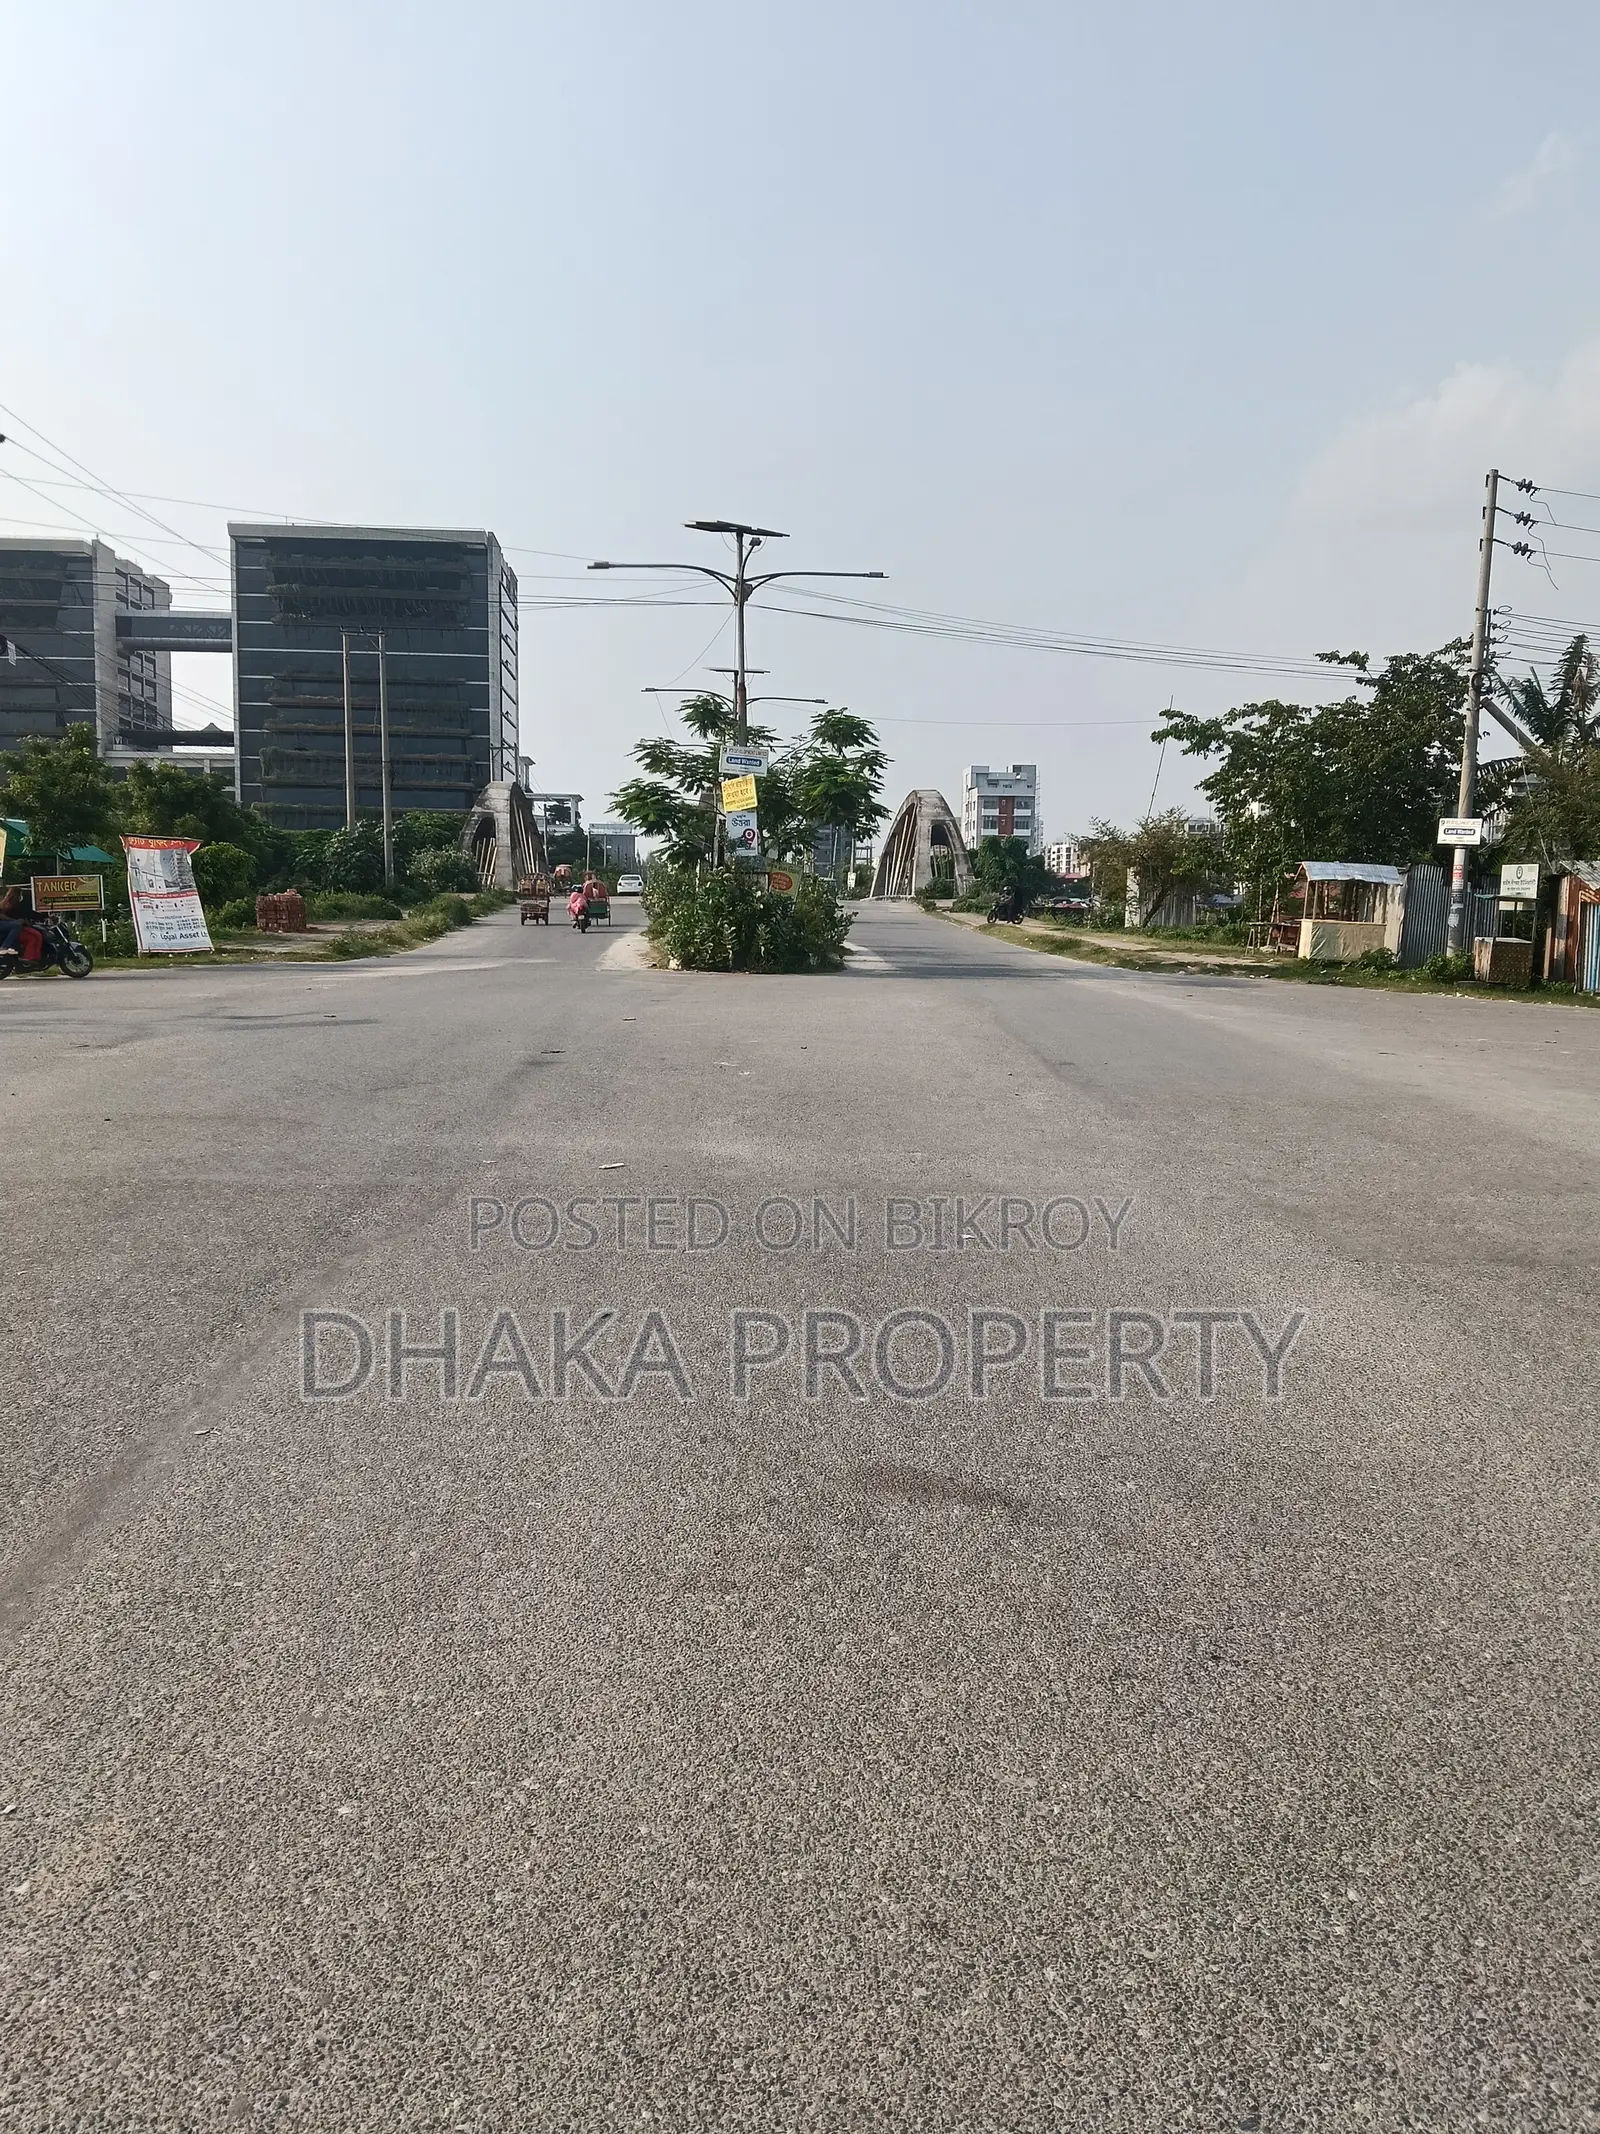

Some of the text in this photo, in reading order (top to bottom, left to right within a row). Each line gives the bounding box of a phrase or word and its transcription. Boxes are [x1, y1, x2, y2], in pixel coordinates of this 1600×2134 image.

[741, 758, 760, 766] Wanted
[731, 817, 751, 827] উত্তরা
[36, 881, 77, 892] TANKER
[160, 932, 177, 942] Loyal
[179, 931, 199, 940] Asset
